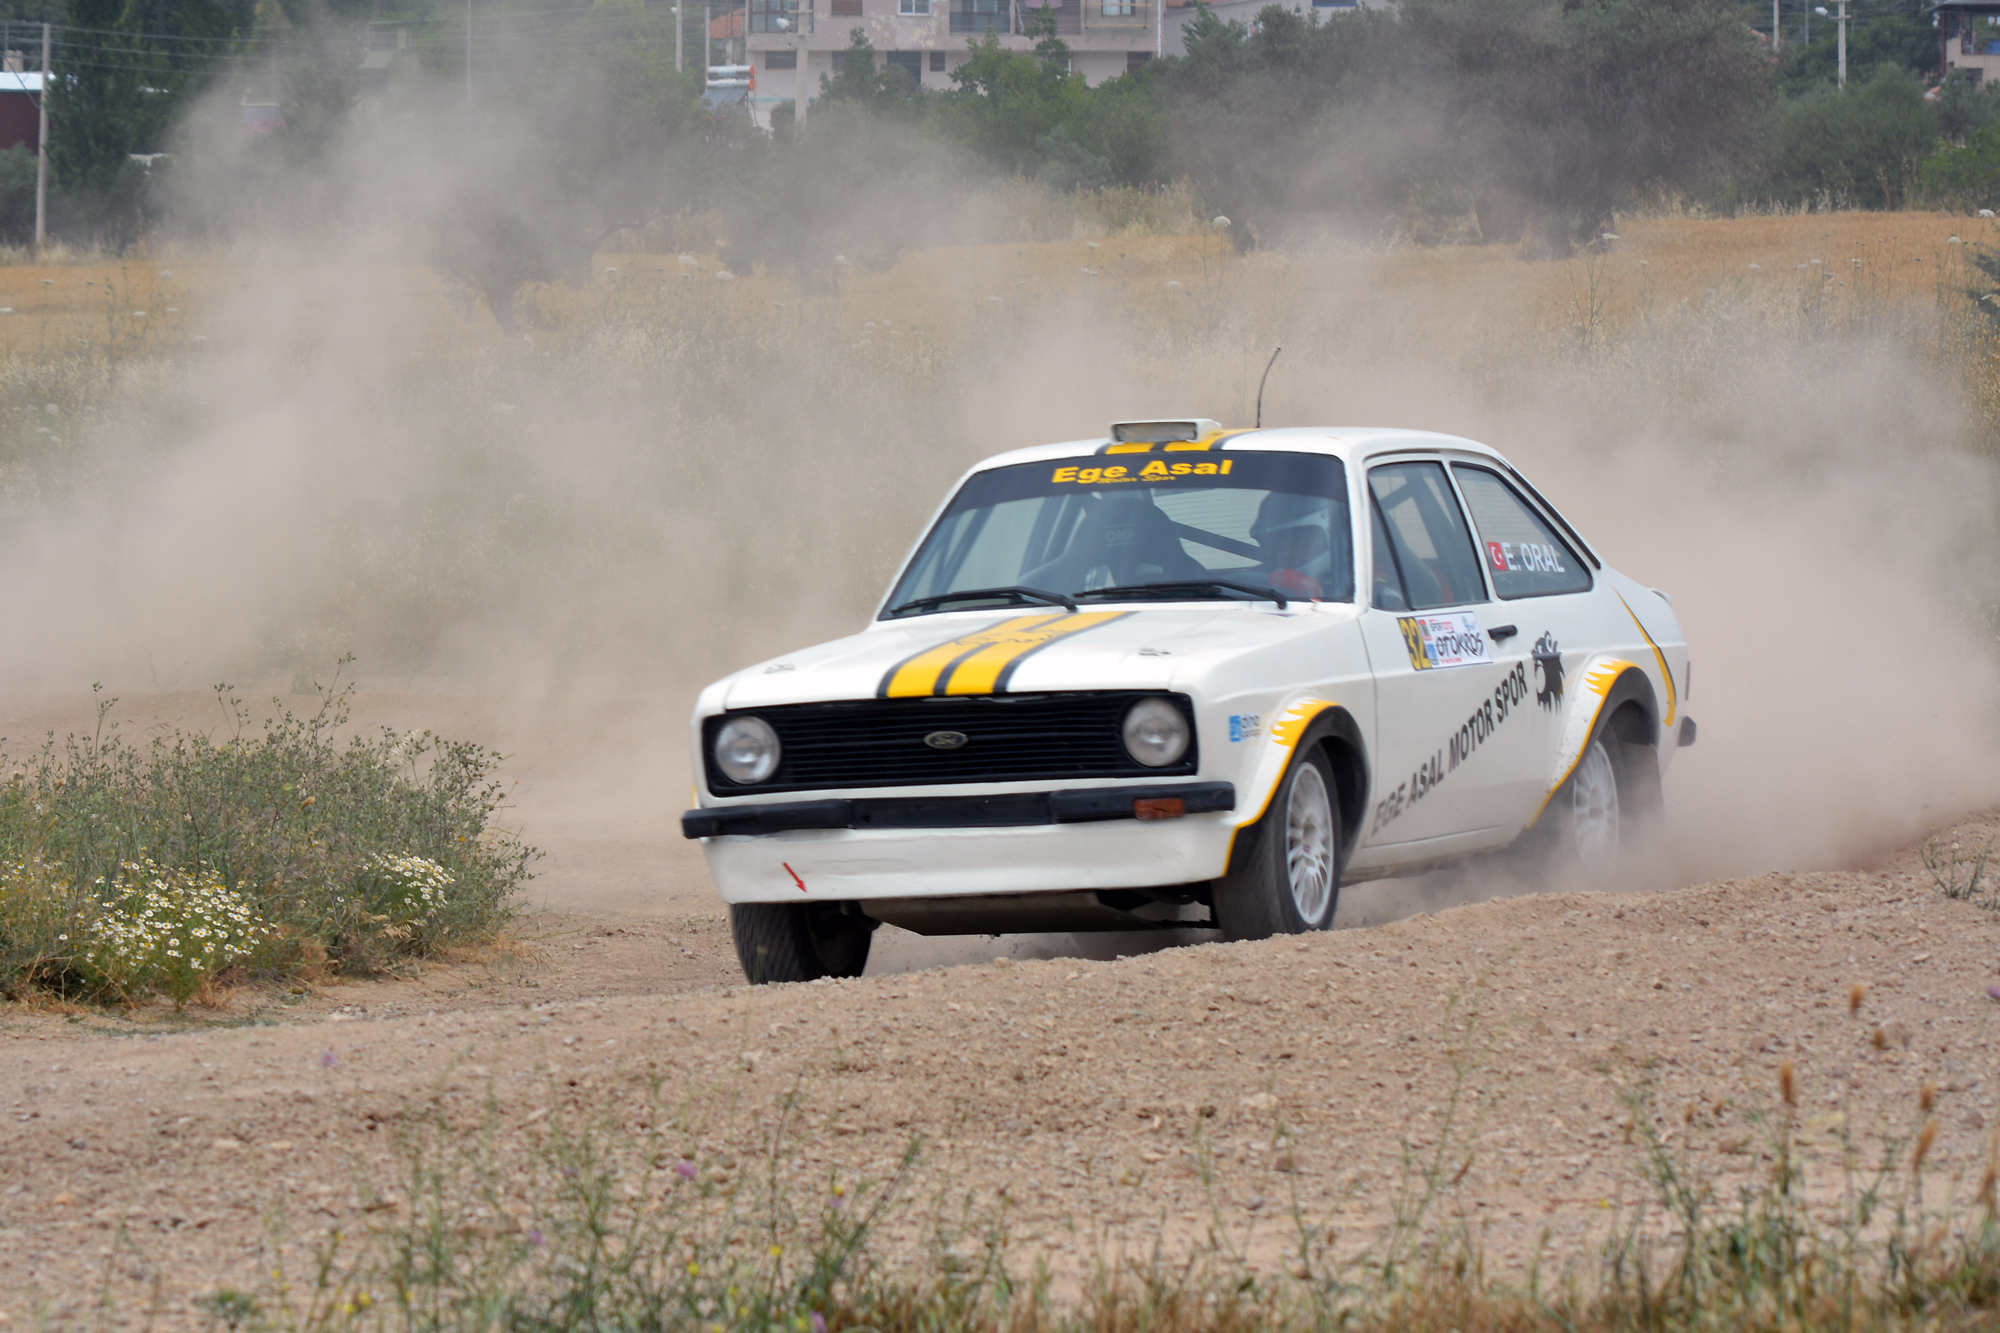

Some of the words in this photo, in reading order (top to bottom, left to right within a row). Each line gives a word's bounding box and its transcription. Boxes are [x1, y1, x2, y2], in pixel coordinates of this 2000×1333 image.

[1052, 466, 1128, 484] Ege
[1139, 459, 1233, 475] Asal
[1501, 542, 1521, 571] E.
[1520, 543, 1566, 572] ORAL
[1400, 618, 1432, 670] 32
[1371, 782, 1406, 837] EGE
[1406, 749, 1444, 810] ASAL
[1448, 698, 1494, 773] MOTOR
[1495, 661, 1528, 723] SPOR
